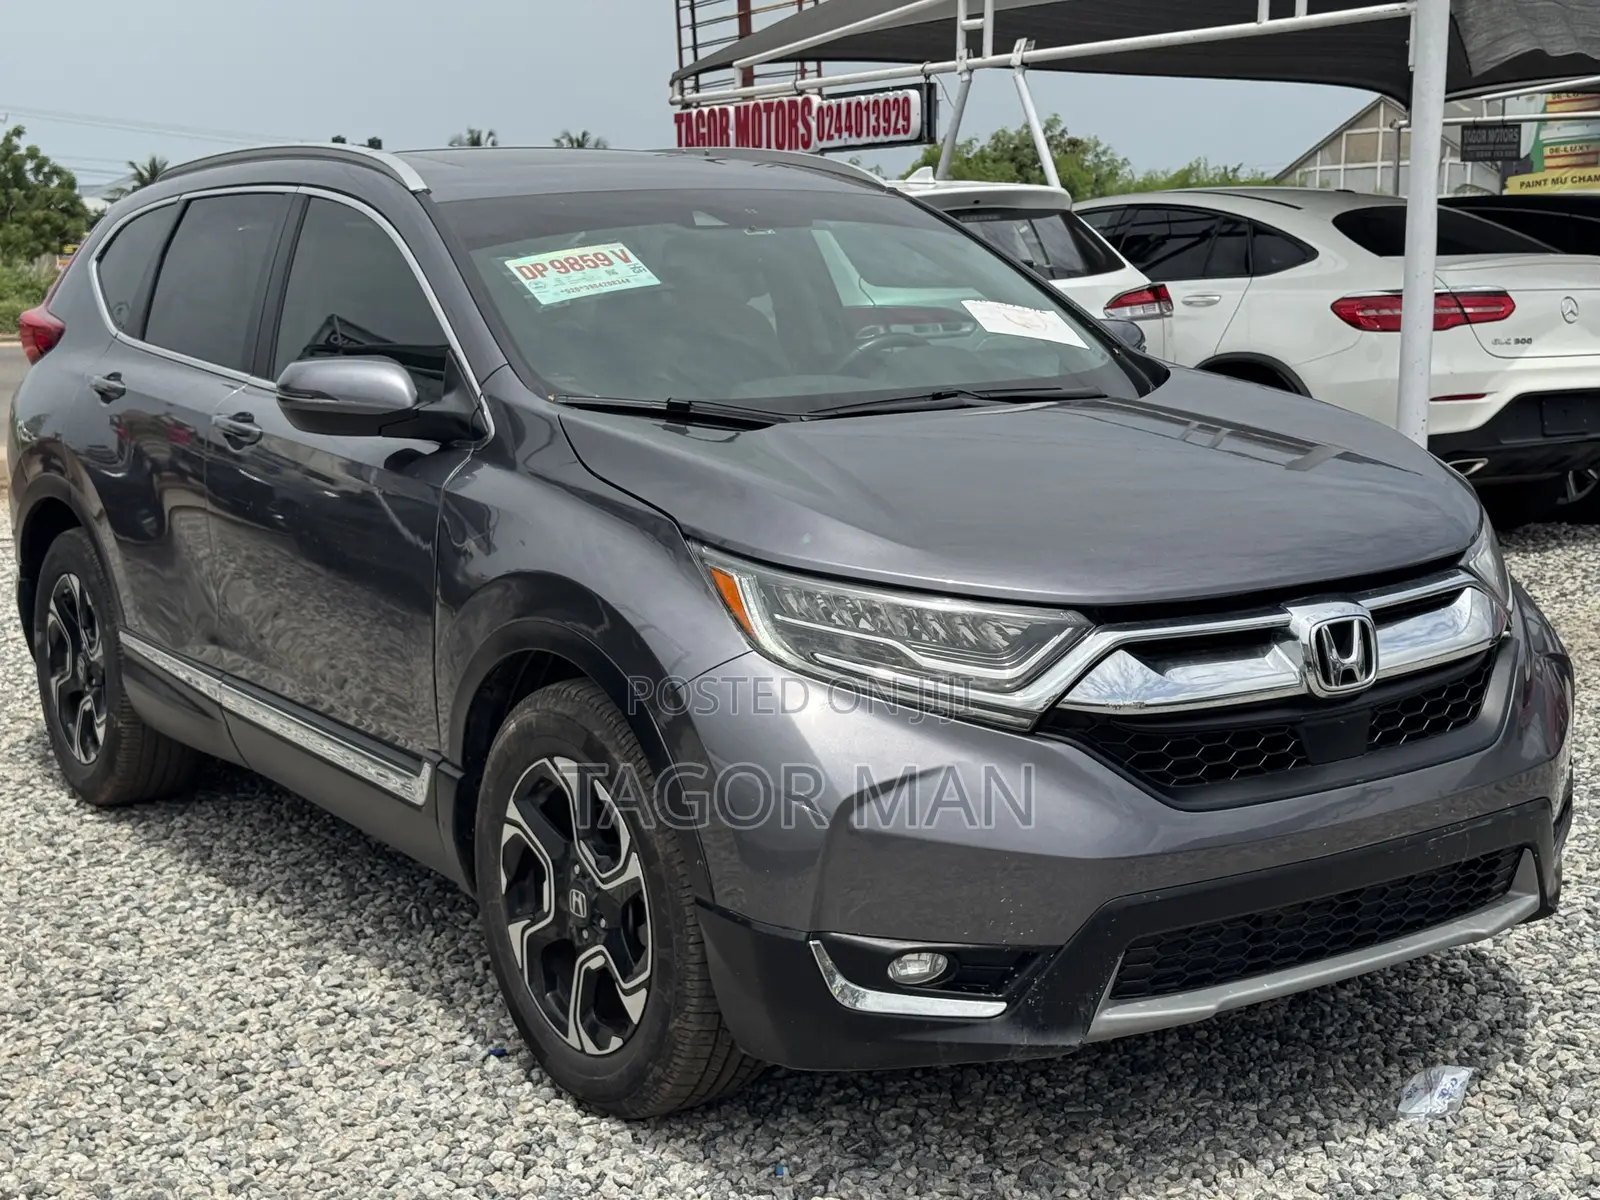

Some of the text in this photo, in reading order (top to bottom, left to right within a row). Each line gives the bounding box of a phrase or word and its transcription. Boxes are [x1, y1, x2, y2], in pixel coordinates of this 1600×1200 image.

[674, 96, 912, 150] TAGOR MOTORS 0244013929
[1519, 178, 1548, 190] PAINT
[515, 262, 549, 281] DP
[549, 251, 614, 275] 9859
[611, 249, 632, 264] V
